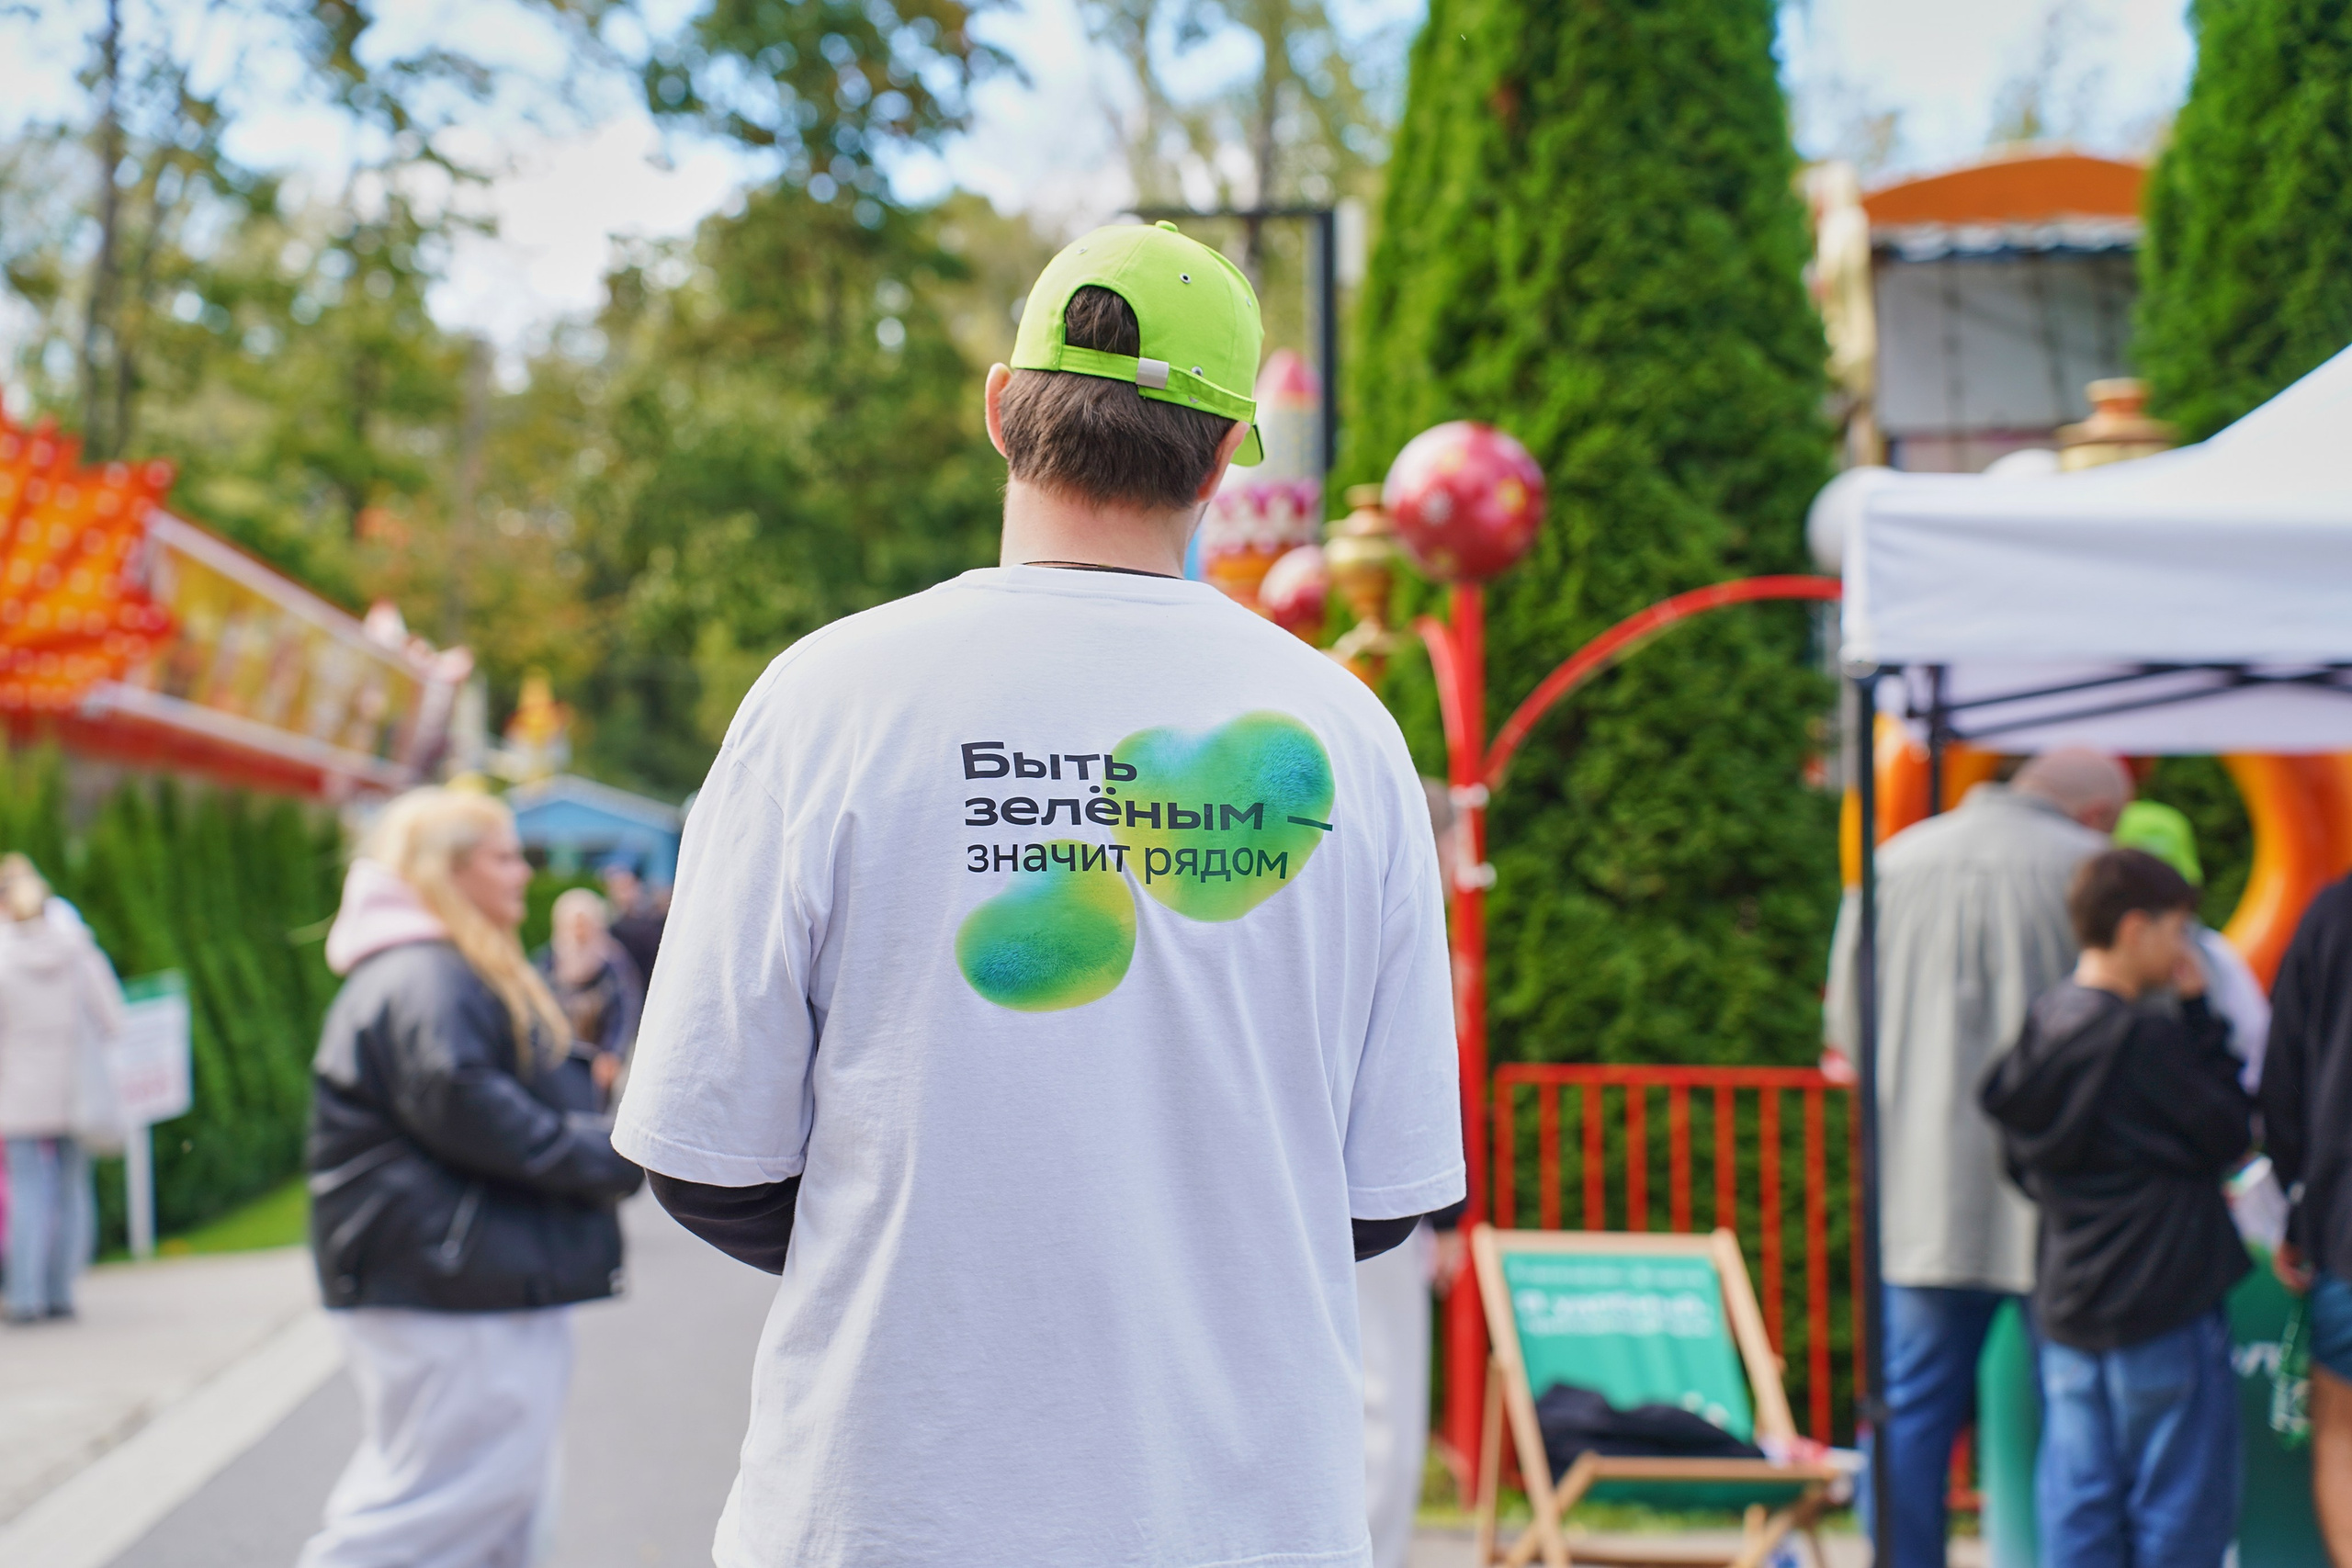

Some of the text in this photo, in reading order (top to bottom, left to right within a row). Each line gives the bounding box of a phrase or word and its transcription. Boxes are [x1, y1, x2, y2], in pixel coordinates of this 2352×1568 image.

[960, 740, 1137, 782] Быть
[964, 784, 1265, 831] зелёным
[967, 842, 1288, 885] значит рядом
